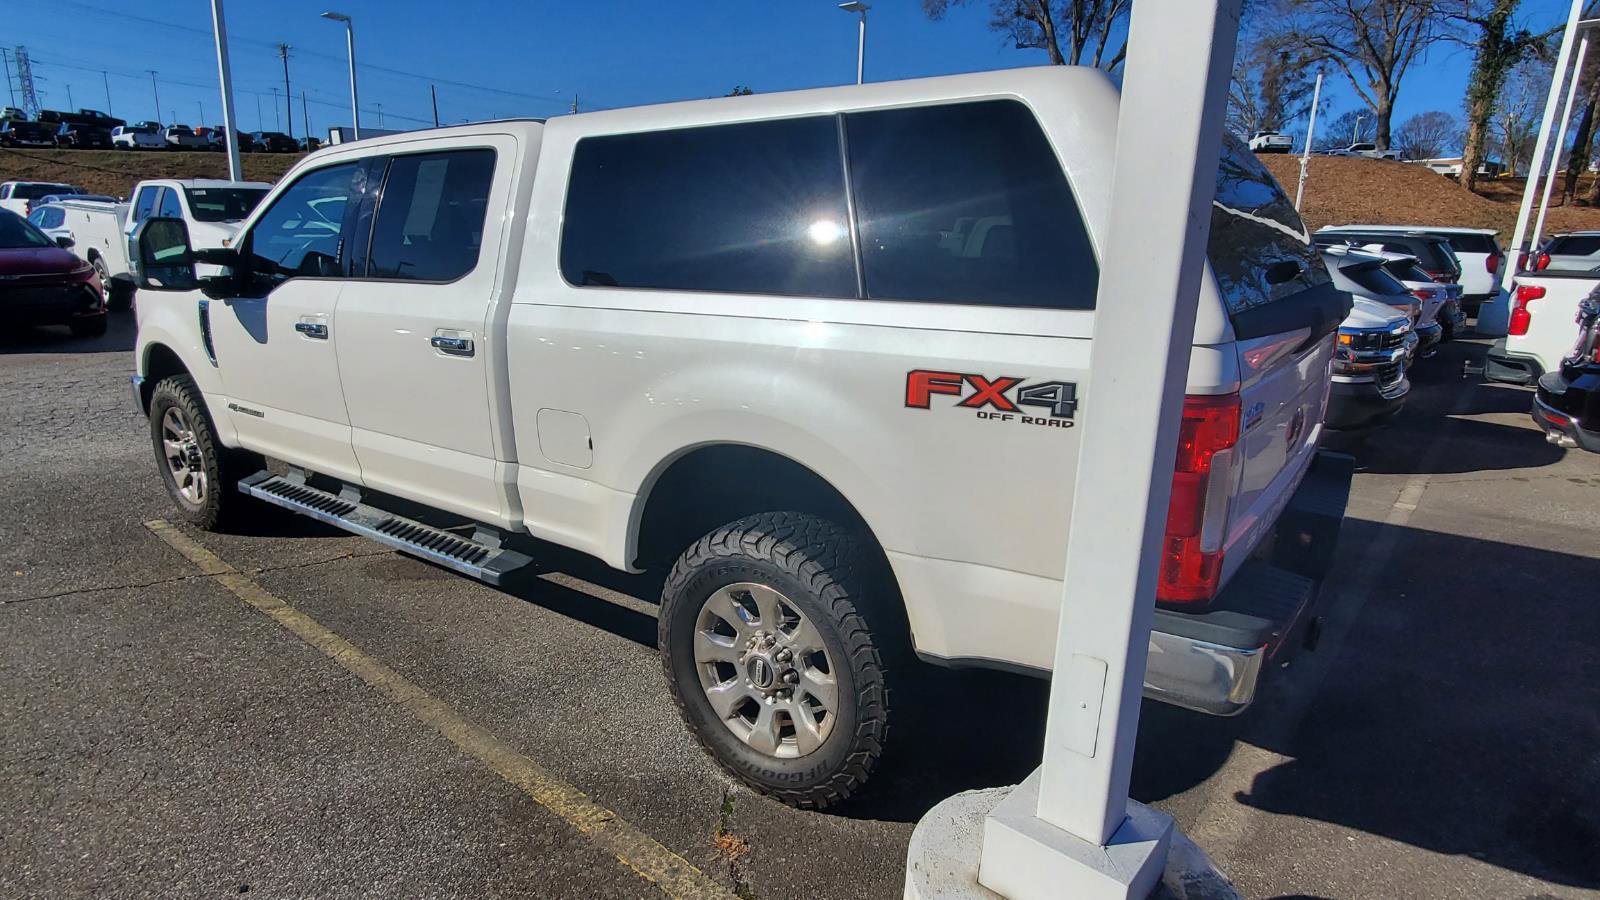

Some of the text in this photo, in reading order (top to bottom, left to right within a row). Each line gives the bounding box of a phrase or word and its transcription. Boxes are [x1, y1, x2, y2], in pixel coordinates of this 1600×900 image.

[905, 369, 1078, 419] FX4
[977, 411, 1075, 429] OFF ROAD
